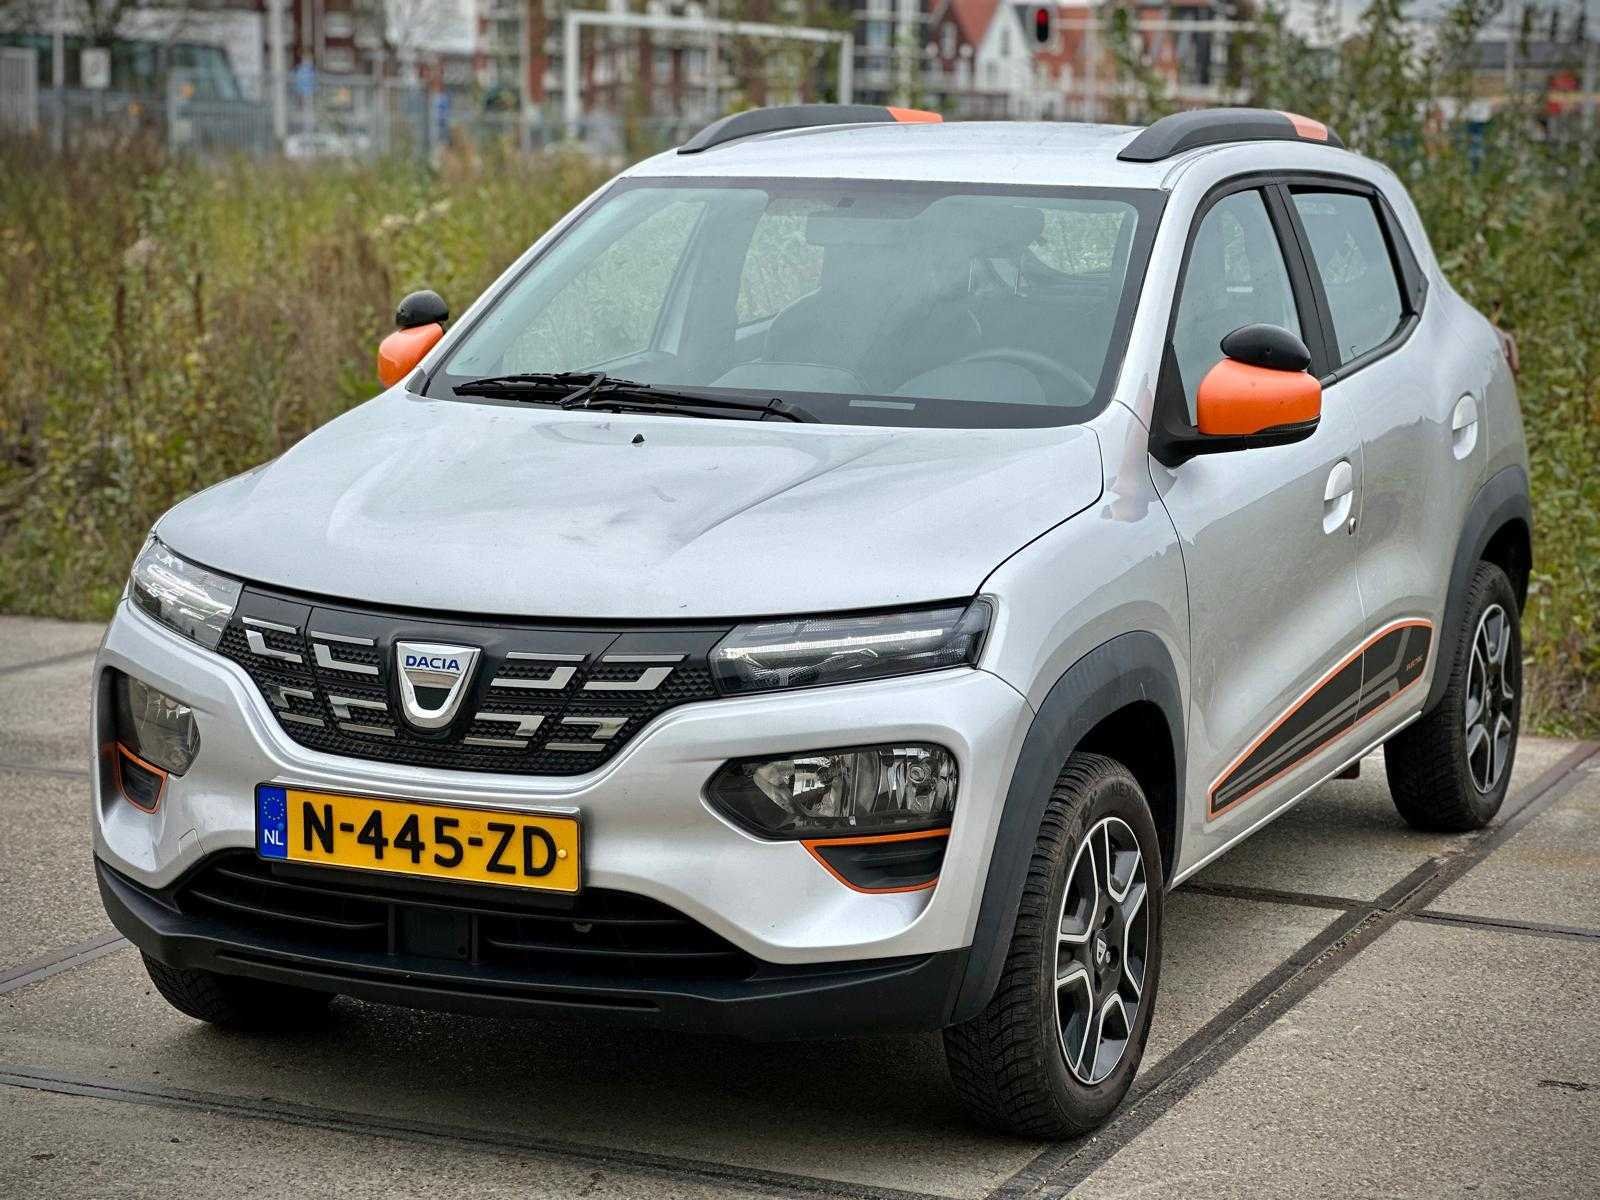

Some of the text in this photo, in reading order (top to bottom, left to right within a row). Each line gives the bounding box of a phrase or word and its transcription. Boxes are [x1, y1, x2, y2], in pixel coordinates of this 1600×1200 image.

[405, 655, 460, 671] DACIA
[264, 828, 284, 846] NL
[302, 801, 558, 877] N-445-ZD
